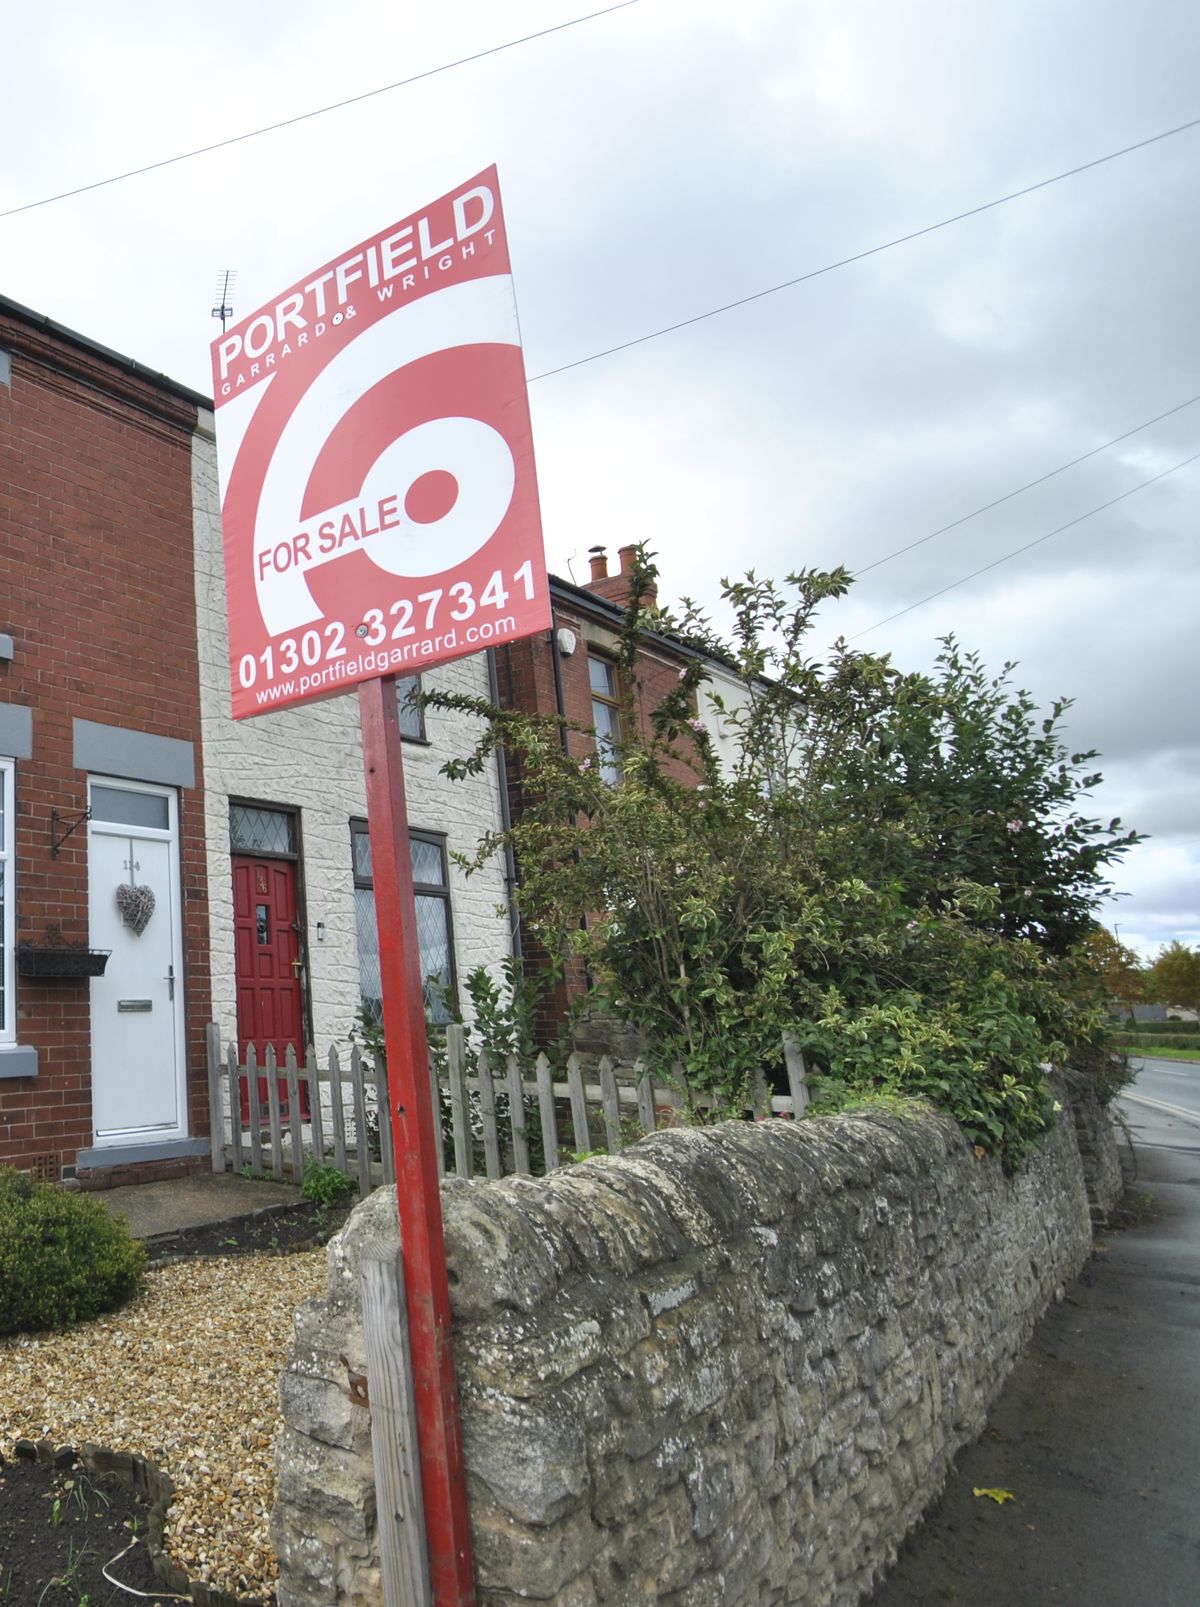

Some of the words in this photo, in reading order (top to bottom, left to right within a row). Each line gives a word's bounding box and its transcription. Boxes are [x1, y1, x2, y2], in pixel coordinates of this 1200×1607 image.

[219, 185, 494, 380] PORTFIELD
[221, 322, 325, 396] GARRARD
[345, 305, 357, 320] &
[377, 229, 496, 302] WRIGHT
[258, 532, 313, 581] FOR
[318, 495, 400, 553] SALE
[239, 621, 347, 688] 01302
[362, 560, 535, 647] 327341
[256, 615, 516, 704] www.portfieldgarrard.com
